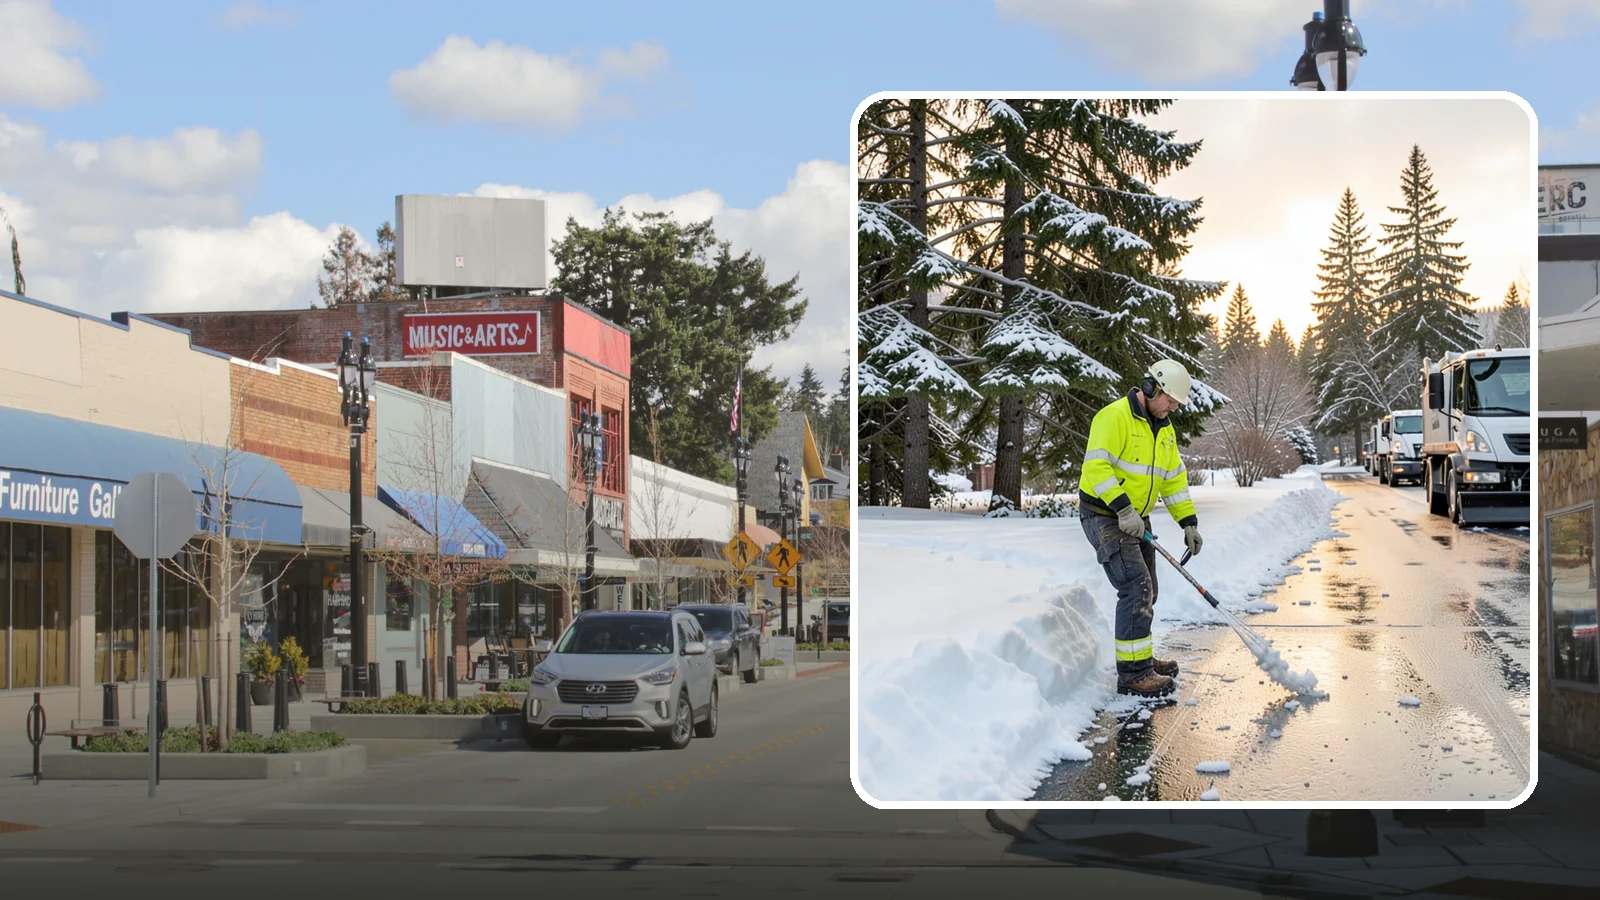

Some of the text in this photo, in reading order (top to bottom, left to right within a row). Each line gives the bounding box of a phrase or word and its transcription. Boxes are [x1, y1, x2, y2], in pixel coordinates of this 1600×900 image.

[1540, 428, 1577, 437] UGA
[1552, 436, 1579, 445] Framing
[0, 471, 121, 519] Furniture Gal
[453, 563, 479, 574] SUSHI
